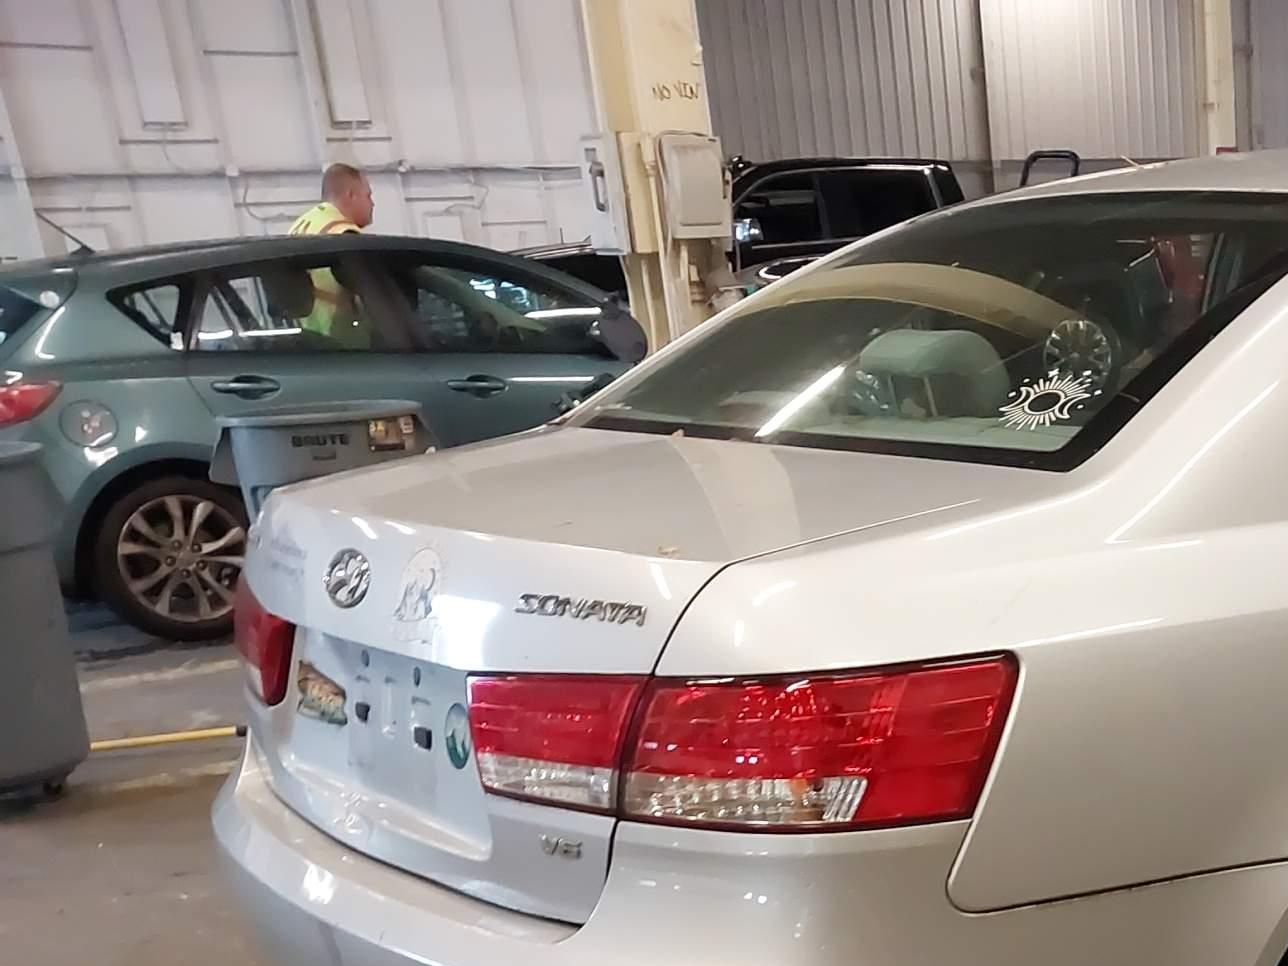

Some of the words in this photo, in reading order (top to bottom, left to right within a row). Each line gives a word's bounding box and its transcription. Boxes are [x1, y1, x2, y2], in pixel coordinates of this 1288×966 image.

[291, 433, 350, 448] BRUTE
[514, 593, 648, 627] SONATA
[540, 834, 583, 860] V6
